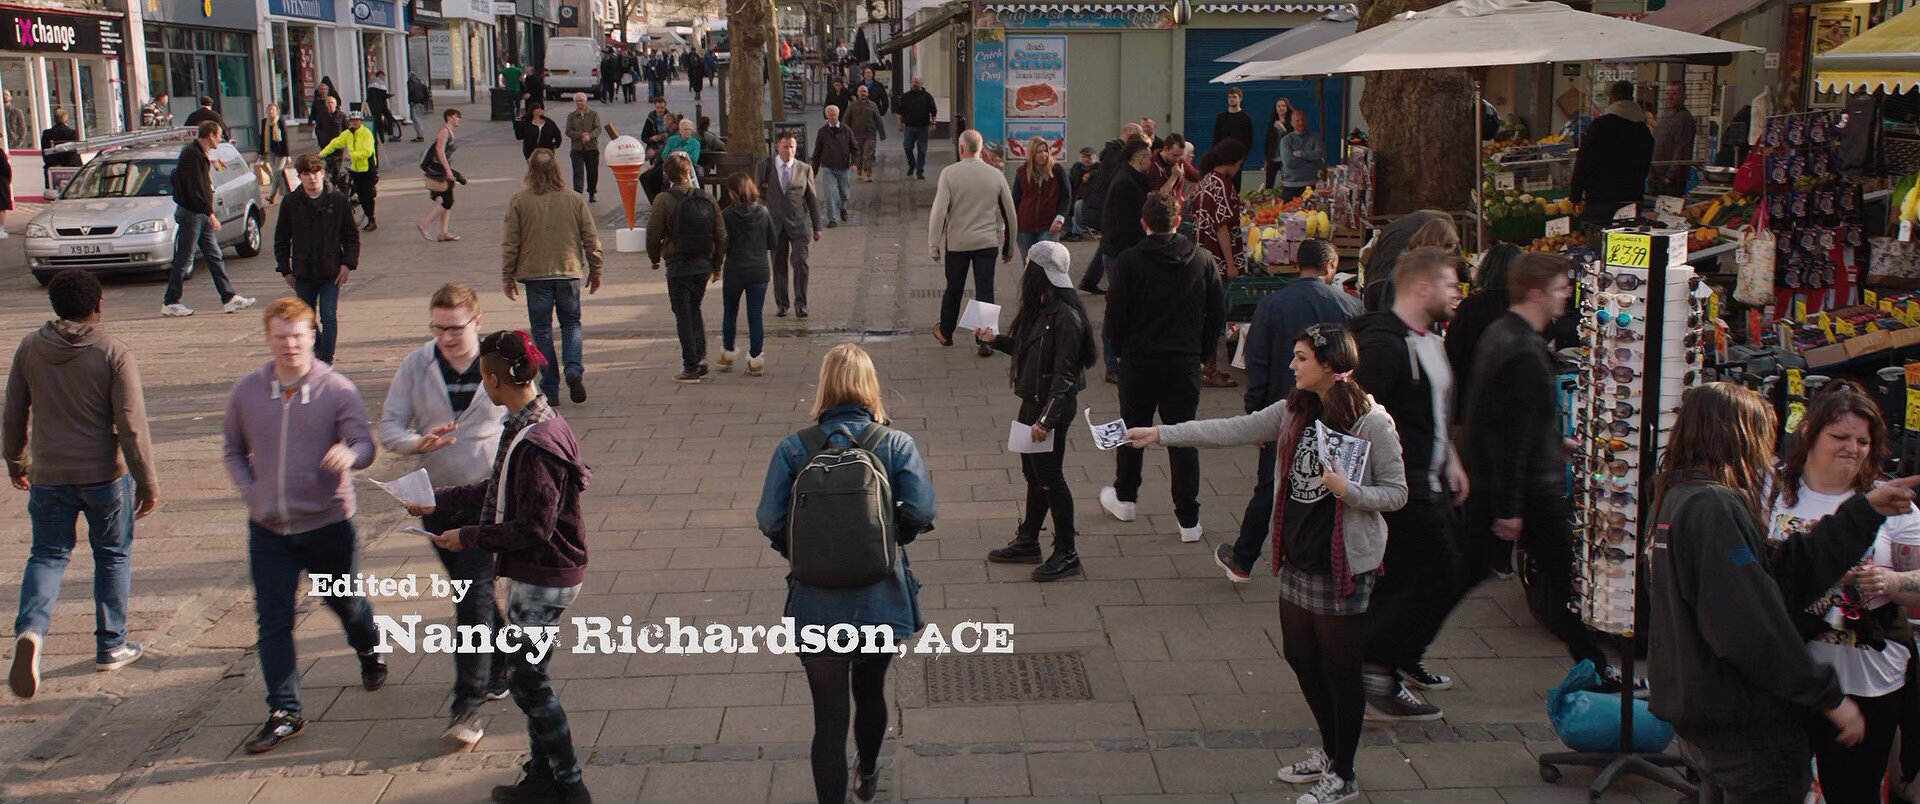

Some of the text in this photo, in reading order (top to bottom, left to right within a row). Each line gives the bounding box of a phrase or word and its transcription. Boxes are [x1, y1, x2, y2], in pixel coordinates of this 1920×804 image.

[872, 0, 887, 19] 3
[14, 17, 76, 51] iXchange
[974, 48, 1003, 63] Catch
[981, 70, 1001, 81] Day
[1596, 69, 1636, 82] FRUIT
[70, 245, 82, 254] X9
[1346, 439, 1361, 479] WRESTLING
